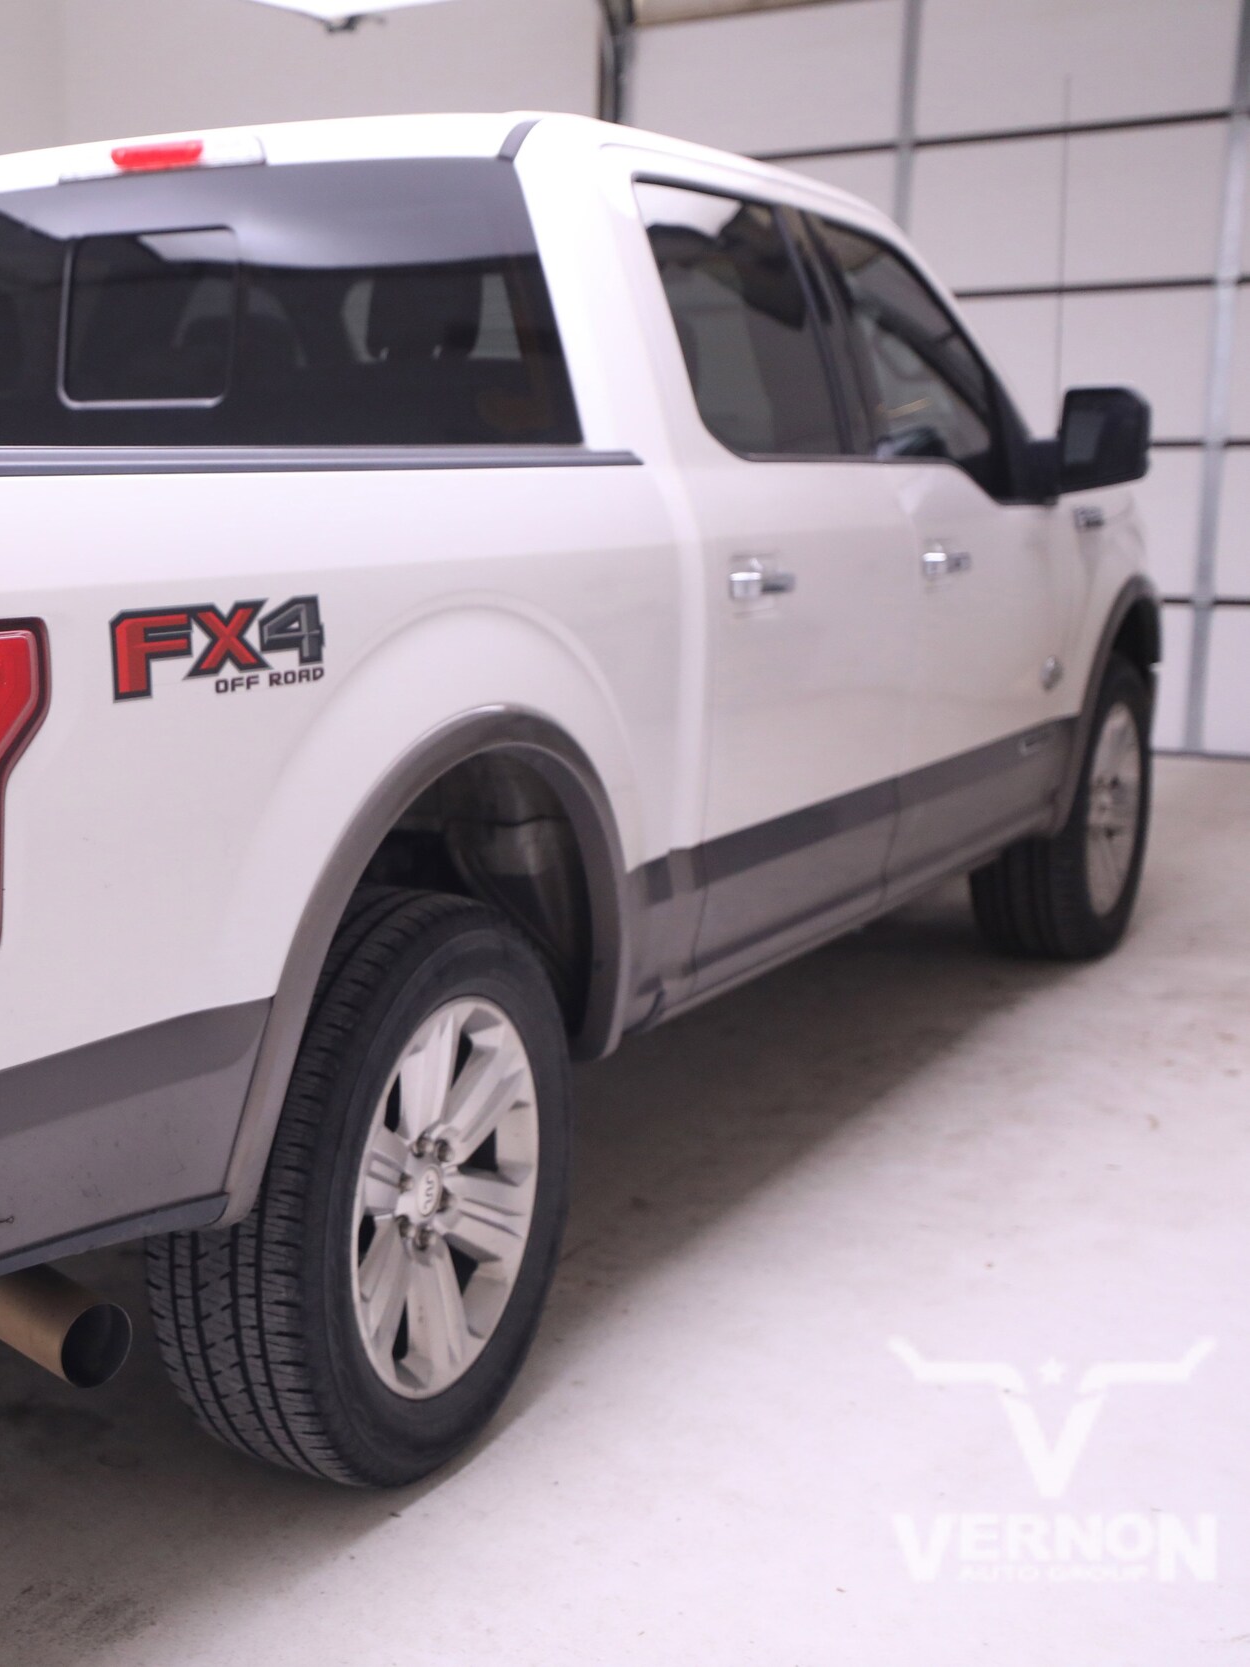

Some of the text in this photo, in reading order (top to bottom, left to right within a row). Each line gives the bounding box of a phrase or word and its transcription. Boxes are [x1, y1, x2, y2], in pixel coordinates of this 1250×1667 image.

[109, 594, 324, 703] FX4
[214, 666, 325, 694] OFF ROAD
